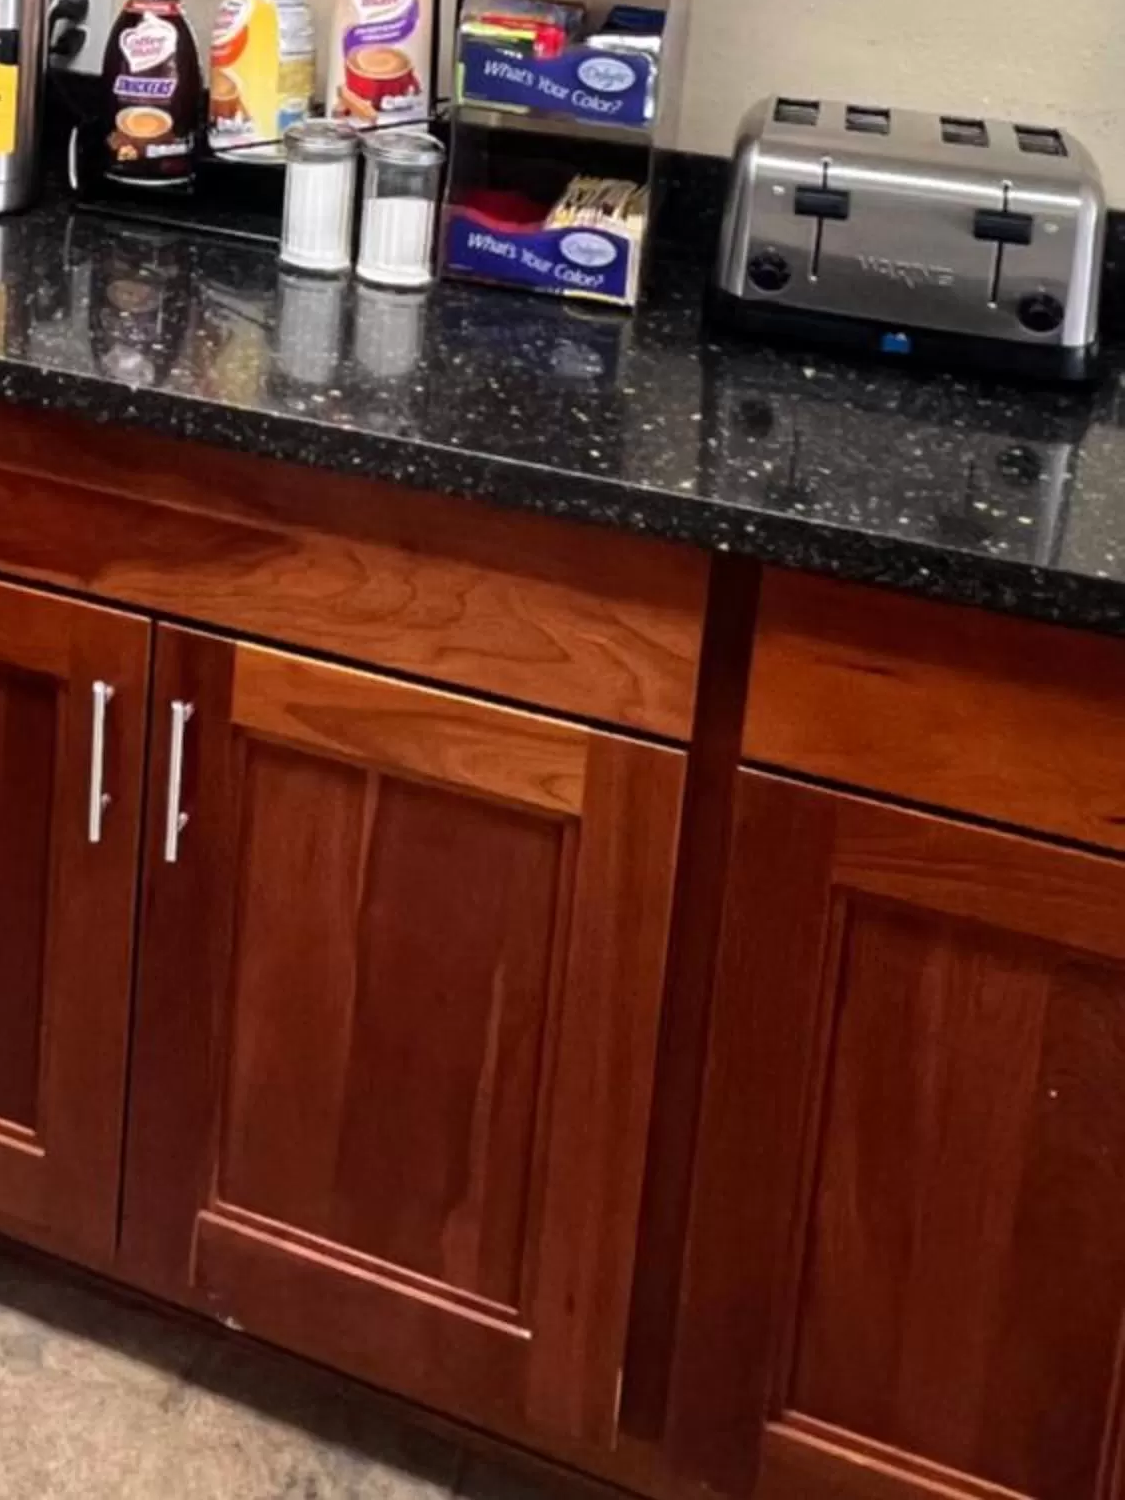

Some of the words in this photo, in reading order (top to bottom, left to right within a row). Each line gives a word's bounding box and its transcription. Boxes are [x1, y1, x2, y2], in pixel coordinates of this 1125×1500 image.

[483, 59, 534, 86] What's
[538, 74, 570, 100] Your
[570, 88, 623, 114] Color?
[467, 232, 517, 259] What's
[521, 247, 554, 274] Your
[553, 262, 605, 287] Color?
